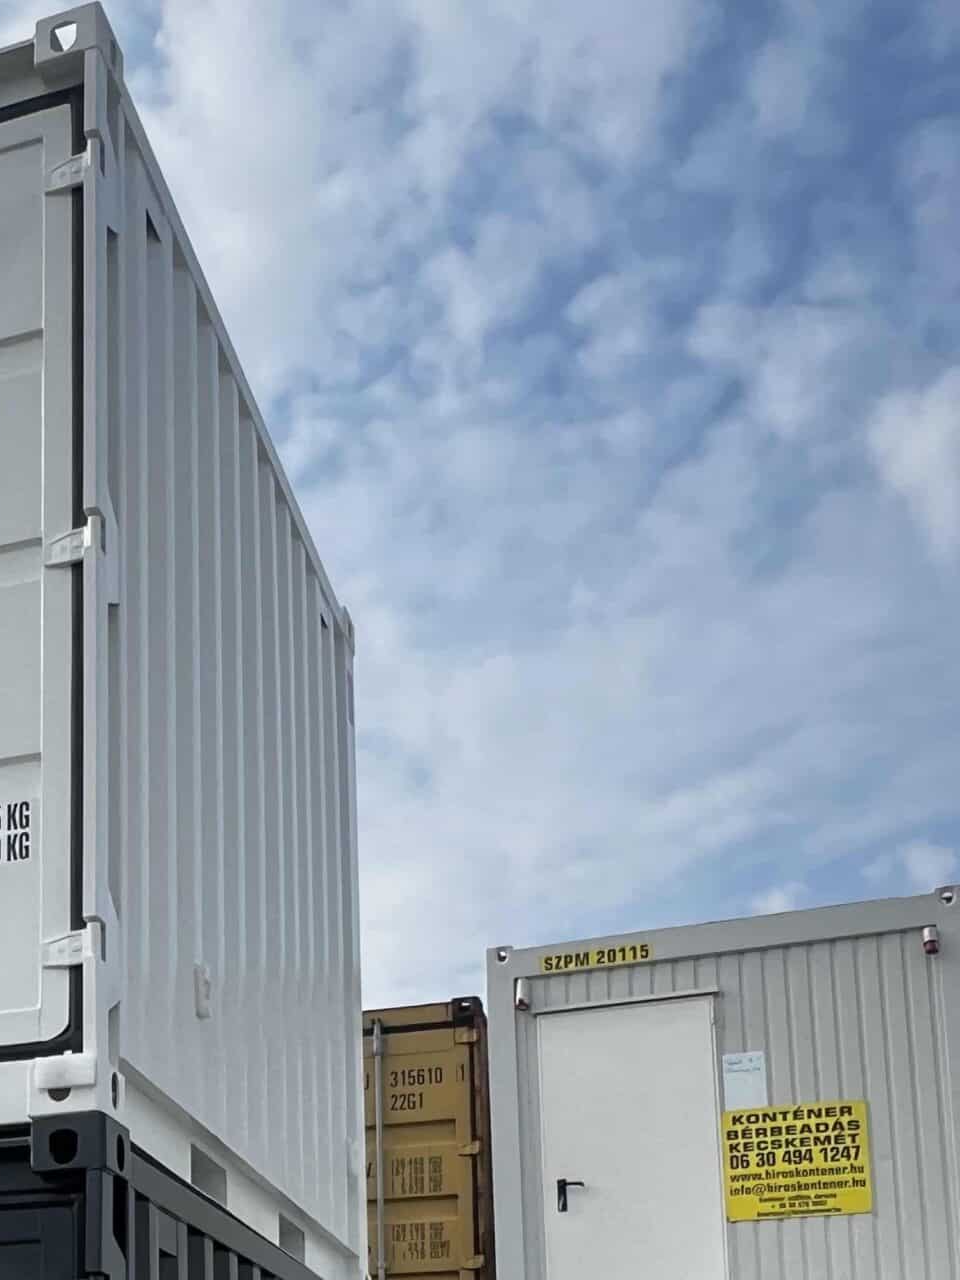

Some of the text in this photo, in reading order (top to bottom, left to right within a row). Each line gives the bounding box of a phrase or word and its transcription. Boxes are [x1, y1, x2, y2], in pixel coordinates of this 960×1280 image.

[7, 801, 30, 831] KG
[7, 832, 30, 861] KG
[544, 944, 649, 971] SZPM 20115
[390, 1067, 443, 1088] 315610
[390, 1092, 424, 1111] 22G1
[732, 1105, 853, 1126] KONTÉNER
[726, 1119, 861, 1141] BÉRBEADÁS
[728, 1133, 860, 1154] KECSKEMÉT
[730, 1145, 861, 1170] 06 30 494 1247
